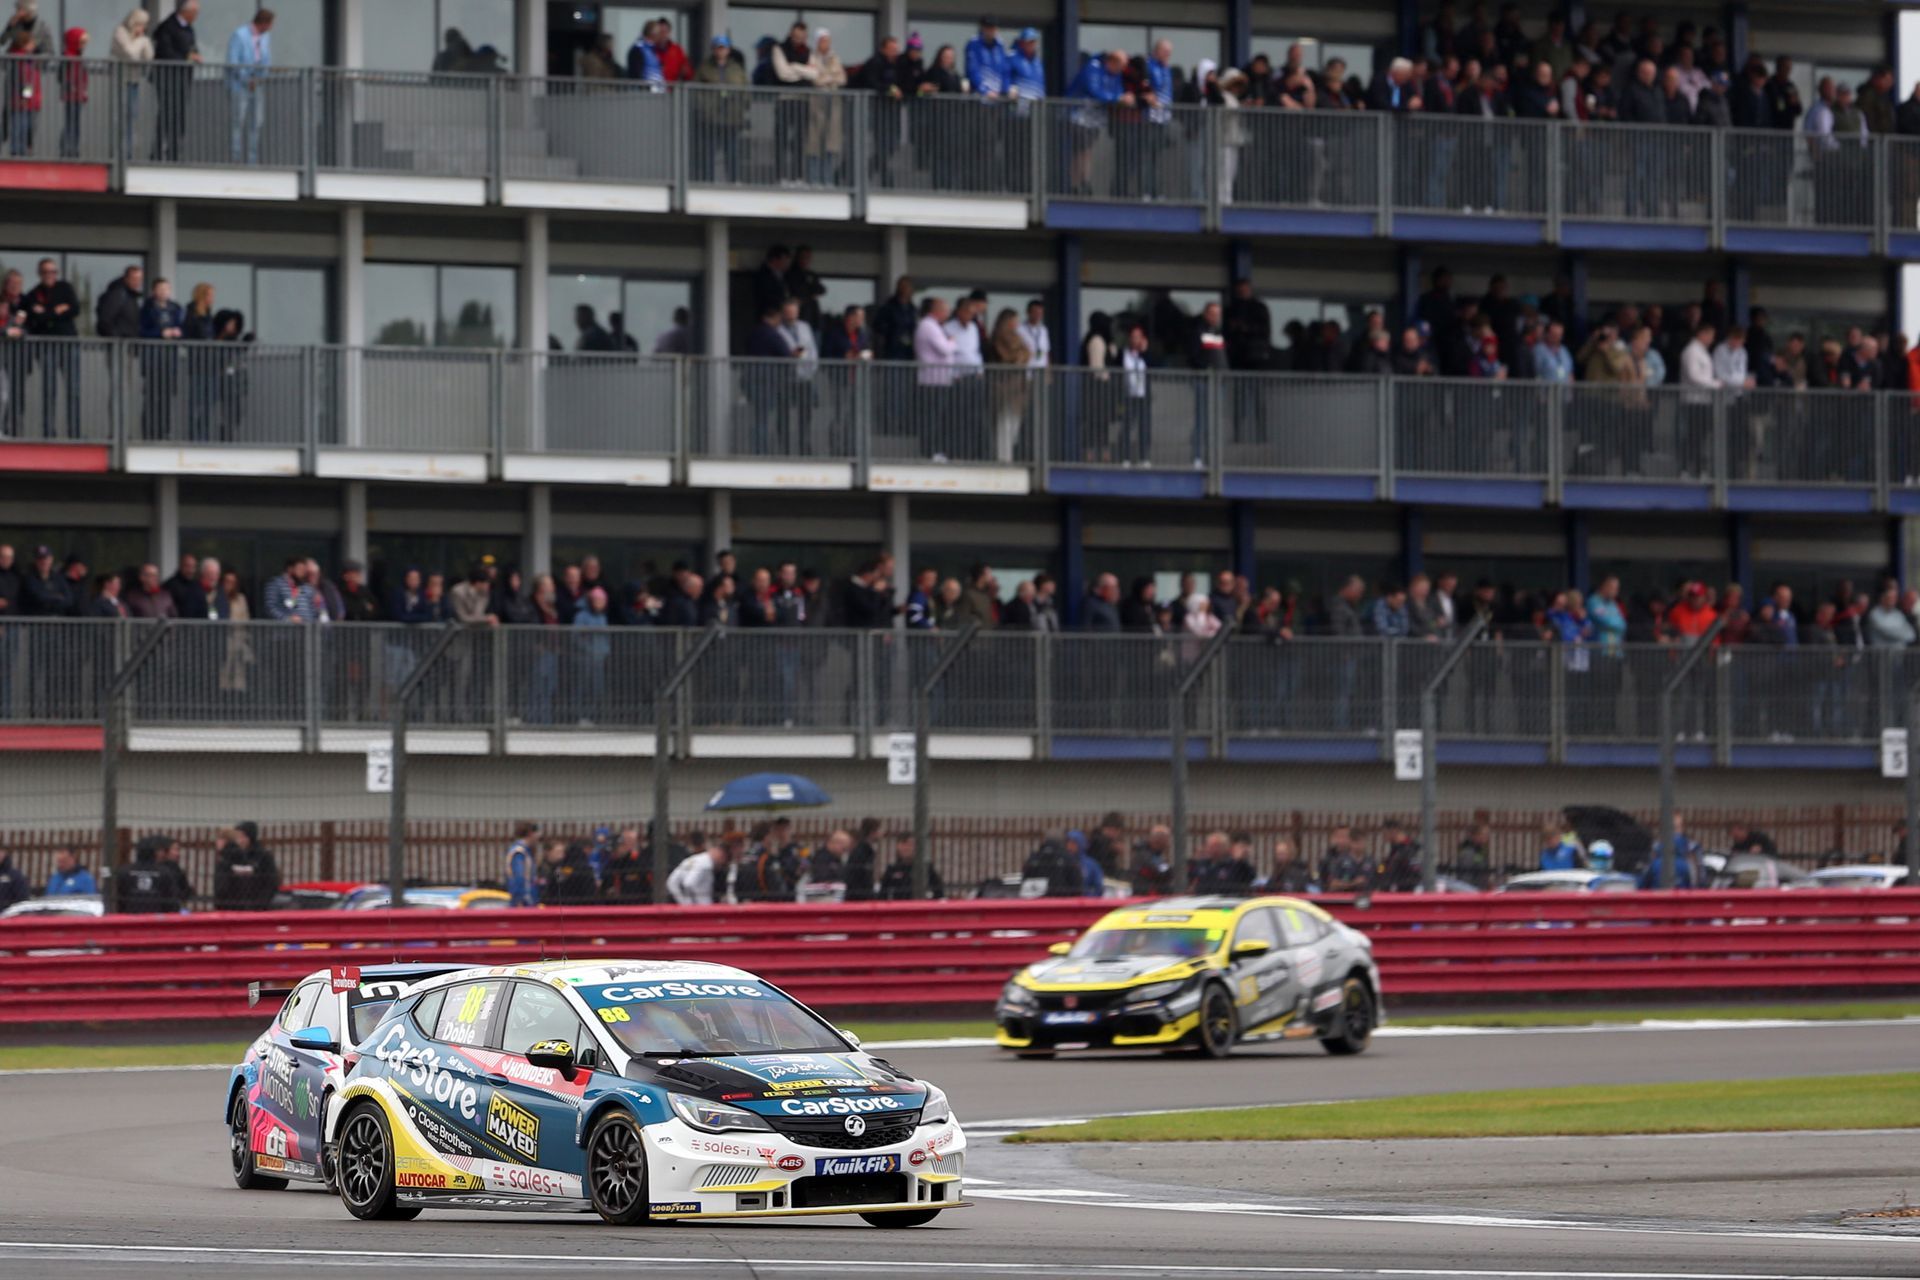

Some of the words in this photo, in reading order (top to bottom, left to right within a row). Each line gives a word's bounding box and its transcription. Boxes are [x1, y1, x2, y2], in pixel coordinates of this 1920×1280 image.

[898, 758, 910, 776] 3
[1405, 753, 1416, 770] 4
[377, 764, 388, 784] 2
[333, 977, 356, 989] HOWDENS
[458, 985, 486, 1024] 88
[597, 1007, 631, 1023] 88
[533, 1041, 570, 1052] PMR
[269, 1046, 296, 1086] STREET
[507, 1060, 557, 1085] HOWDENS
[264, 1069, 294, 1115] MOTORS
[775, 1080, 822, 1090] POWER
[491, 1097, 536, 1139] POWER
[418, 1111, 439, 1133] Close
[438, 1126, 473, 1156] Brothers
[489, 1114, 534, 1155] MAXED
[704, 1141, 750, 1156] sales-i
[911, 1150, 925, 1162] ABS
[781, 1159, 802, 1167] ABS
[398, 1173, 446, 1187] AUTOCAR
[509, 1168, 564, 1196] sales-i
[651, 1203, 697, 1213] GOODYEAR
